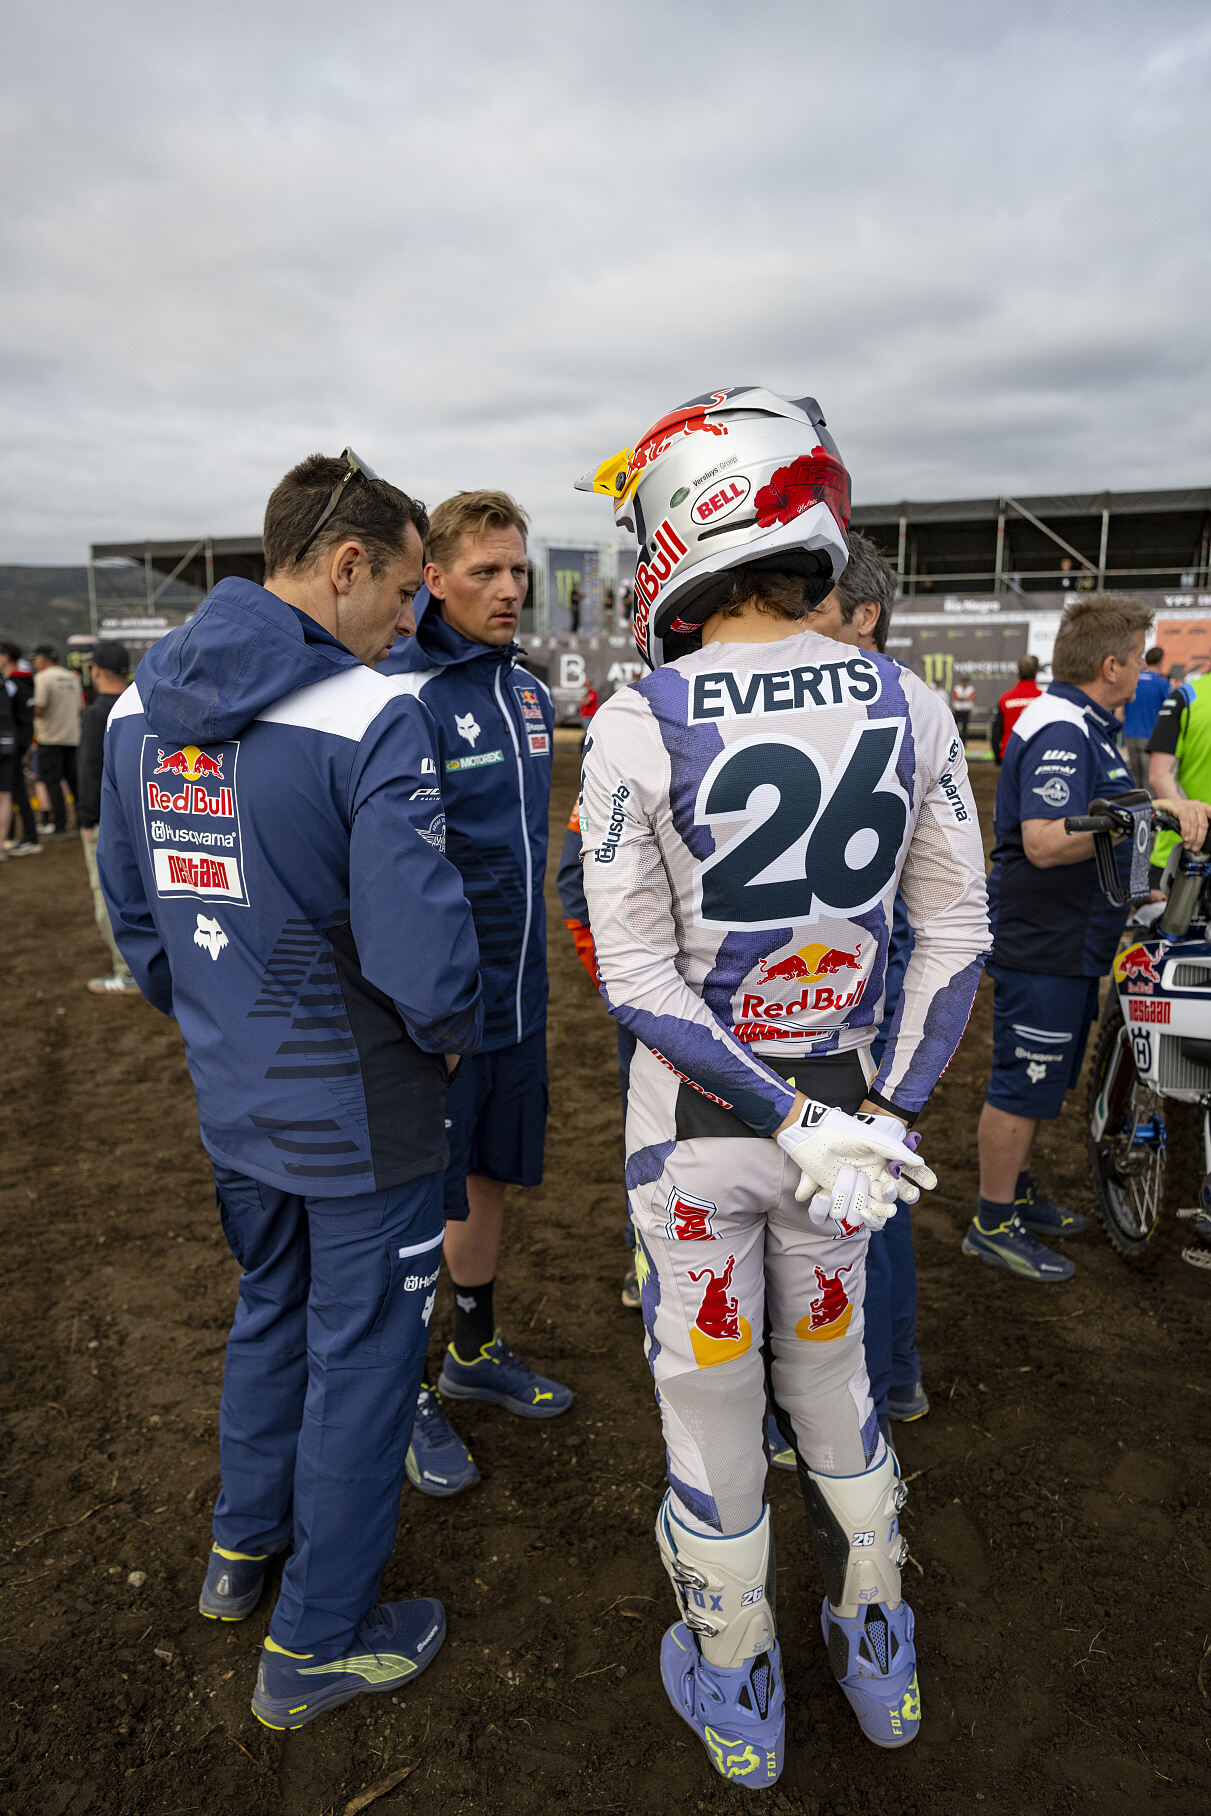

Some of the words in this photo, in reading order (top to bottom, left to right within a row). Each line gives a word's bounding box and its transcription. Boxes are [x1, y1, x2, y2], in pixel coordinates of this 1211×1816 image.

[692, 467, 719, 487] Versluys
[696, 482, 746, 521] BELL
[637, 518, 689, 604] Bull
[692, 656, 880, 720] EVERTS
[460, 751, 501, 769] MOTOREX
[1042, 750, 1078, 762] WP
[148, 783, 190, 812] Red
[193, 786, 234, 816] Bull
[165, 824, 233, 848] Husqvarna
[701, 725, 908, 922] 26
[741, 989, 809, 1019] Red
[811, 977, 867, 1011] Bull
[1128, 1000, 1171, 1024] nestaan
[851, 1531, 876, 1547] 26
[741, 1585, 764, 1607] 26
[888, 1710, 904, 1735] FOX
[766, 1751, 777, 1778] FOX
